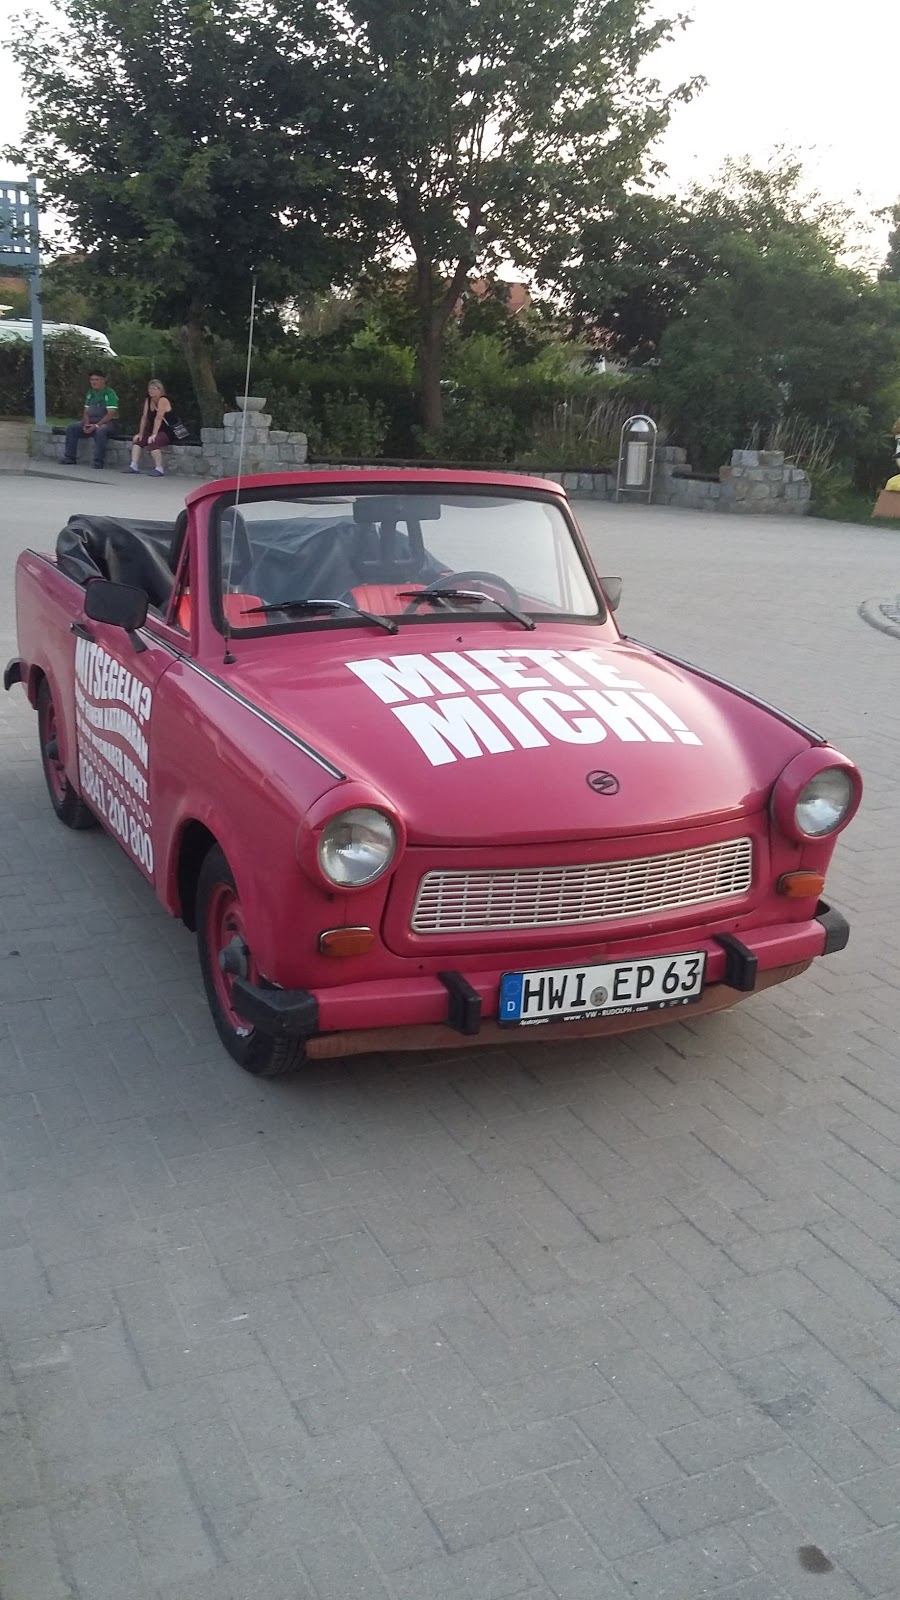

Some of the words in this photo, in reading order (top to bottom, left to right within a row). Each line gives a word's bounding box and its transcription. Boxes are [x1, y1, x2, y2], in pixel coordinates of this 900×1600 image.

[75, 636, 152, 726] MITSEGELN?
[345, 649, 646, 704] MIETE
[390, 689, 704, 767] MICH!
[107, 789, 129, 843] 200
[129, 816, 154, 874] 800
[507, 1001, 516, 1012] D
[523, 973, 587, 1013] HWI
[612, 965, 655, 1002] EP
[662, 958, 701, 994] 63
